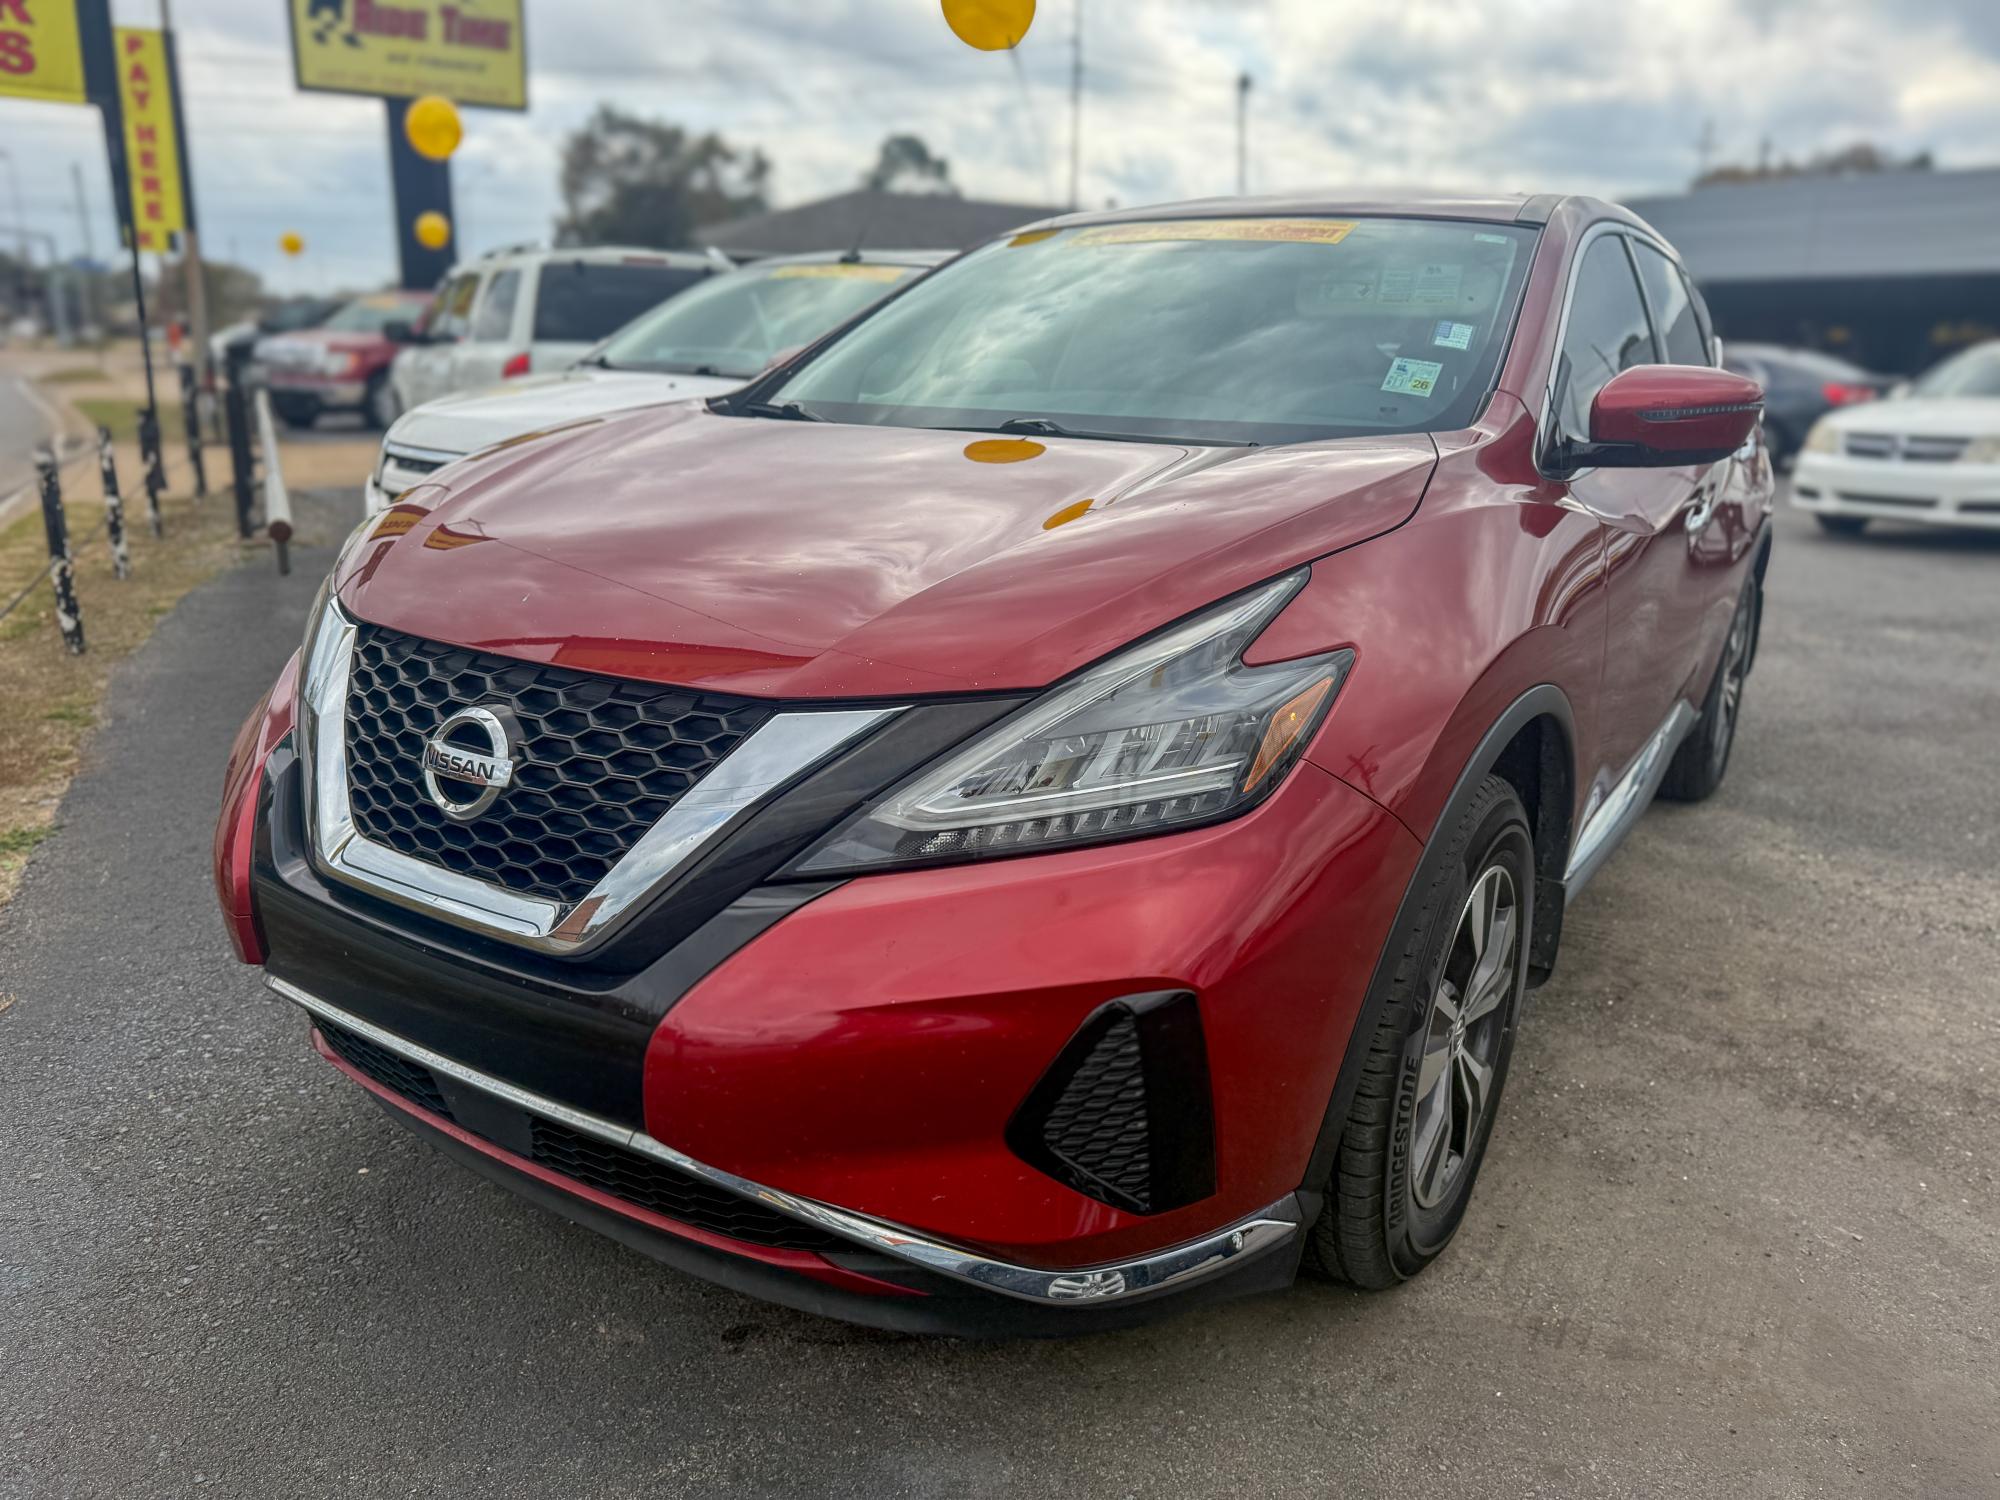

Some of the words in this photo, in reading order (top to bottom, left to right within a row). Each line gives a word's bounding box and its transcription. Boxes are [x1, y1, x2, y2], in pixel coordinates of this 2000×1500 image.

[125, 34, 148, 111] PAY
[135, 123, 163, 220] HERE
[1411, 379, 1430, 390] 26
[425, 746, 496, 781] NISSAN
[1387, 1054, 1420, 1231] BRIDGESTONE
